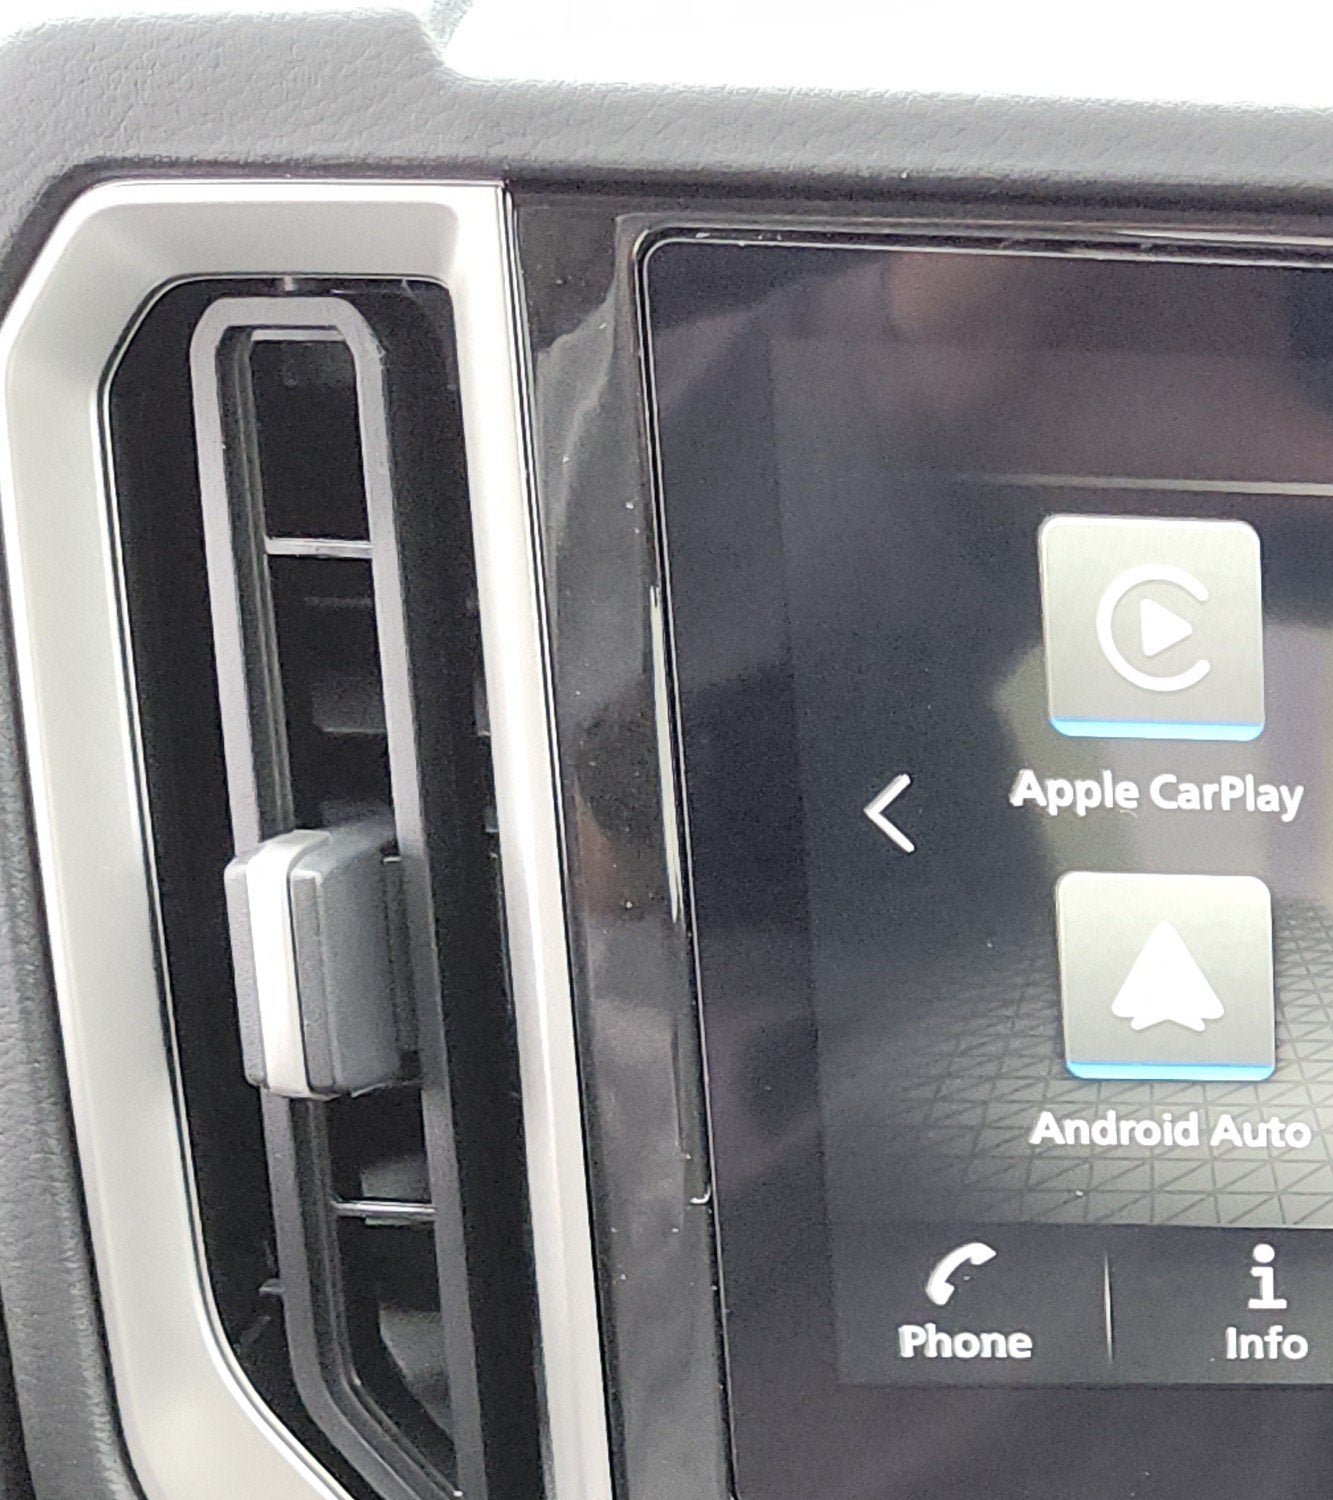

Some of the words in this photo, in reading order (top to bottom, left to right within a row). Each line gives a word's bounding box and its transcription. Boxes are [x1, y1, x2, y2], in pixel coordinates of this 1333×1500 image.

[1010, 769, 1140, 818] Apple
[1148, 773, 1305, 822] CarPlay
[1028, 1110, 1200, 1148] Android
[1210, 1114, 1313, 1150] Auto
[899, 1323, 1034, 1361] Phone
[1225, 1325, 1309, 1362] Info
